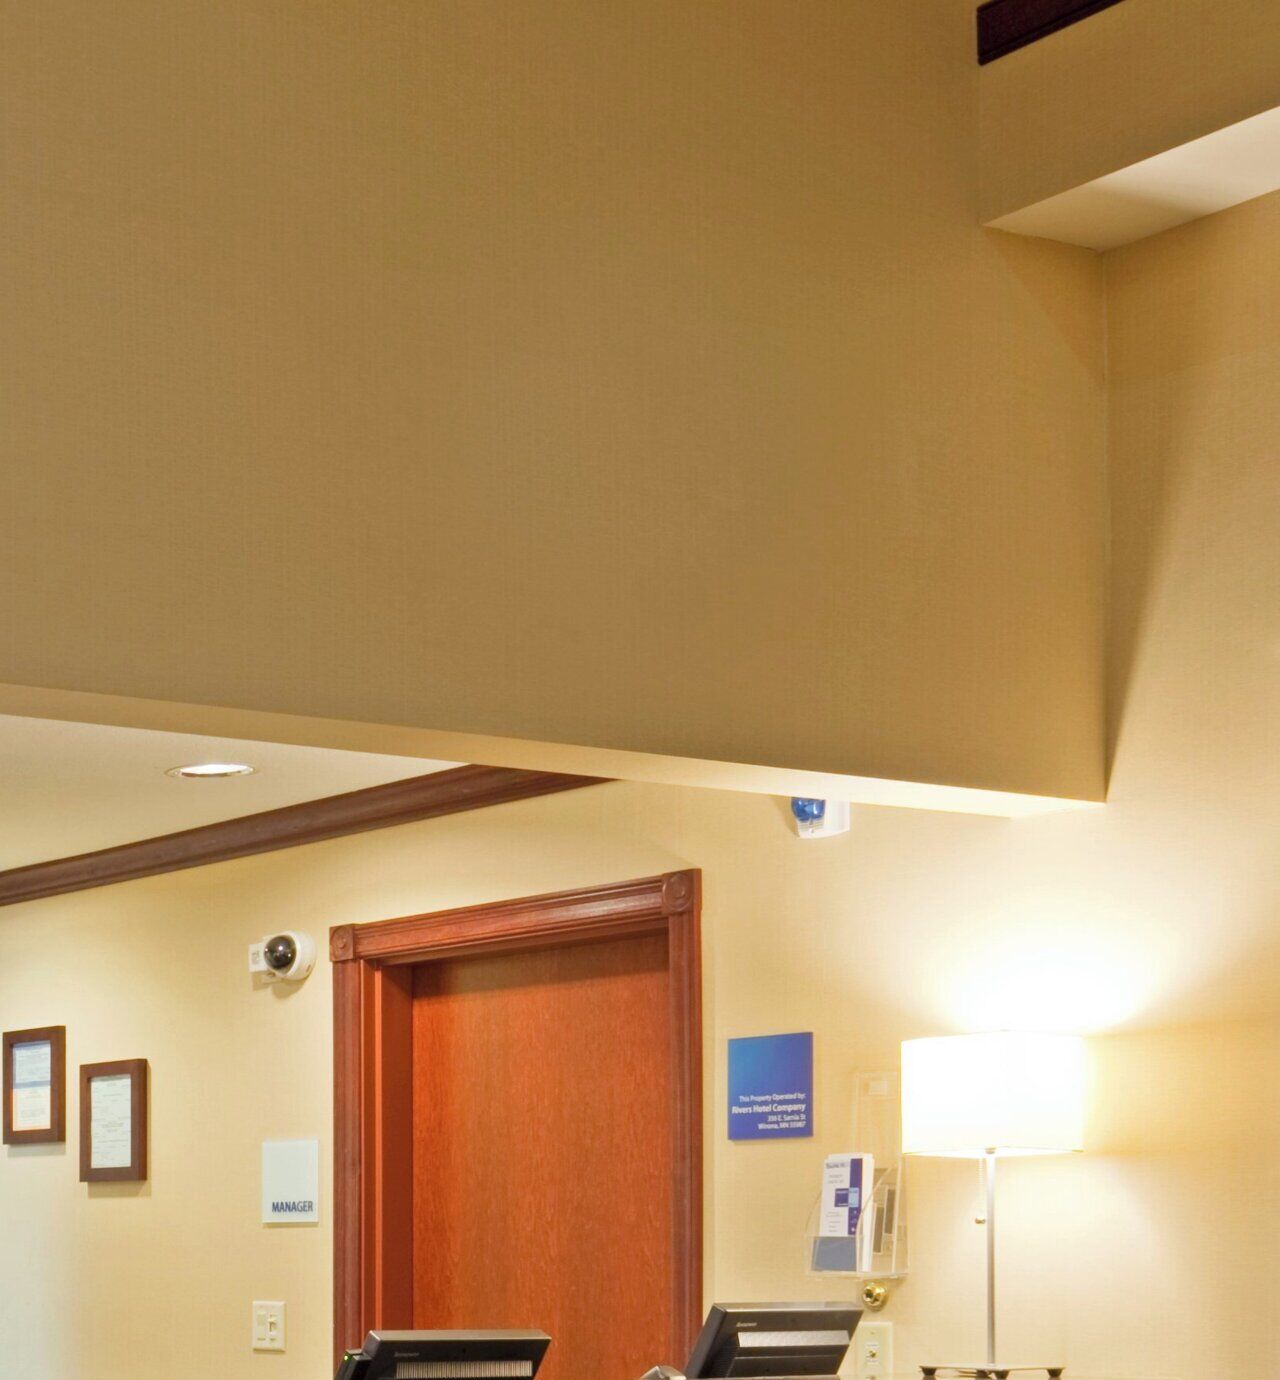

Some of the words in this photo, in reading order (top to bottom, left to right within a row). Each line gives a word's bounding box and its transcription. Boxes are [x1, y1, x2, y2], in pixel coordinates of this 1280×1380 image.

[732, 1106, 753, 1115] Rivers
[753, 1104, 772, 1113] Hotel
[772, 1103, 806, 1113] Company
[272, 1200, 314, 1213] MANAGER
